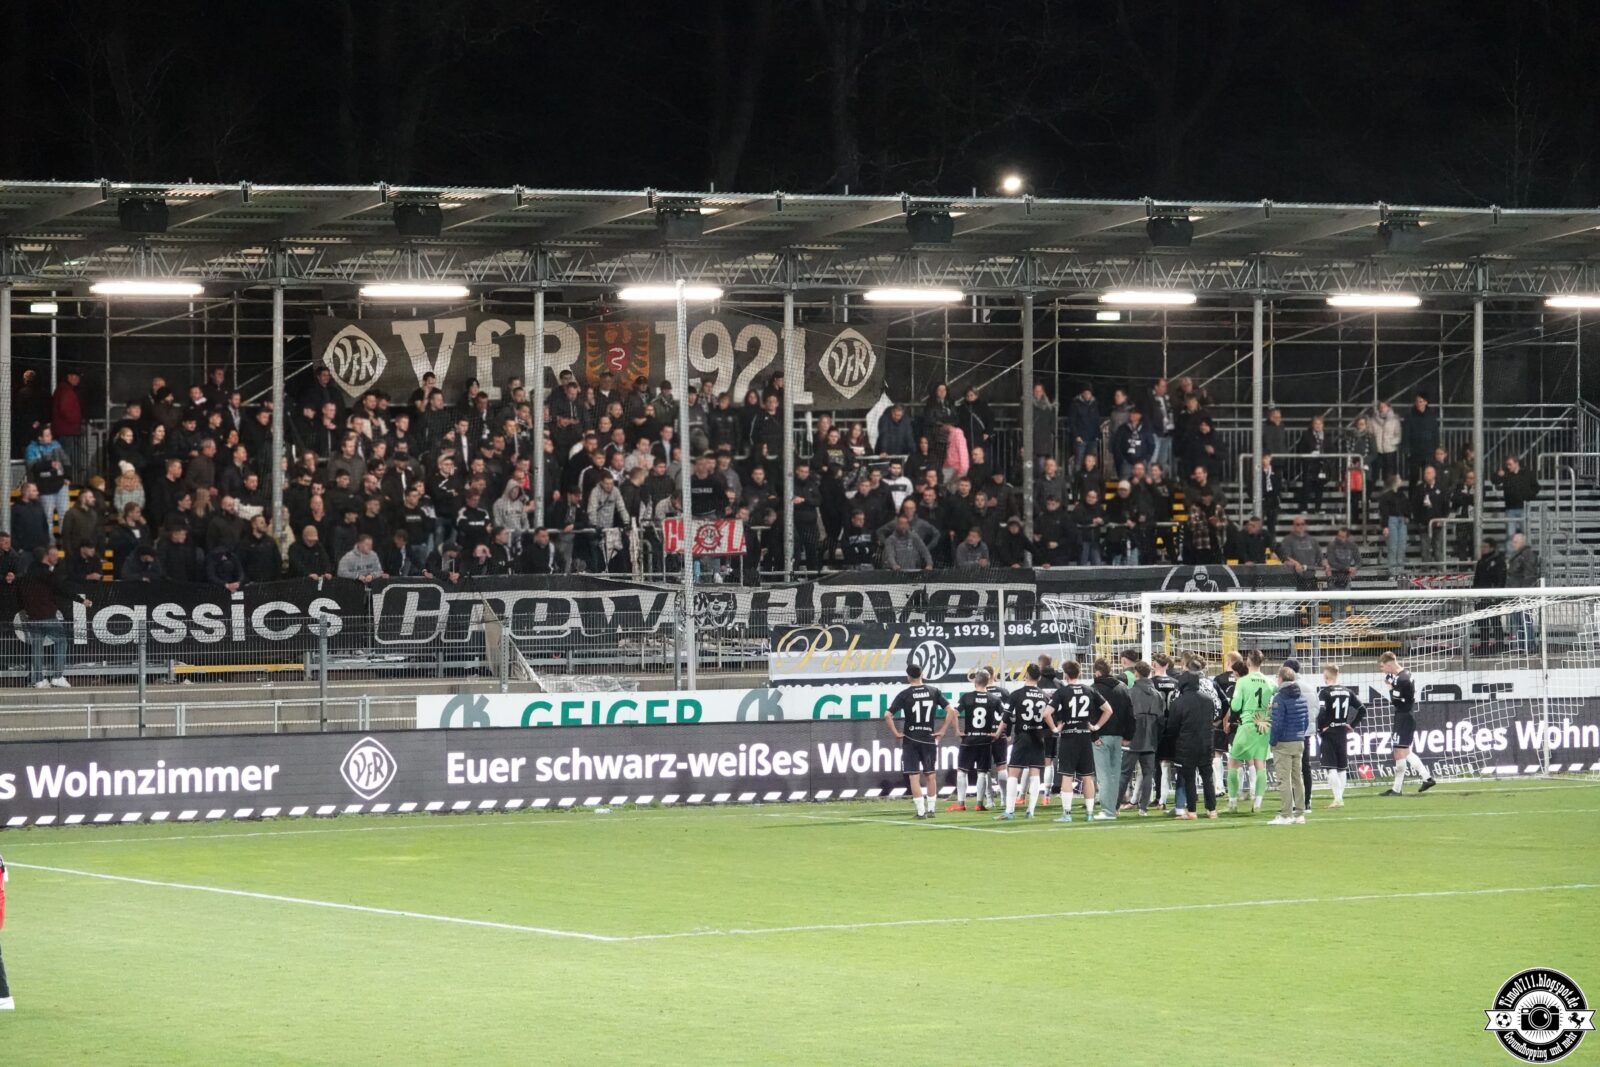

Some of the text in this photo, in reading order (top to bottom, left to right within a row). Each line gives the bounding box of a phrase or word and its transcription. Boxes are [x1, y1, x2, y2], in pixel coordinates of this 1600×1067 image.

[391, 316, 814, 406] VfR 1921
[909, 624, 950, 640] 1972,
[954, 622, 995, 639] 1979,
[1068, 695, 1090, 718] 12
[1254, 687, 1263, 708] 1
[1332, 697, 1349, 719] 11
[911, 700, 934, 723] 17
[972, 707, 987, 729] 8
[1021, 699, 1047, 722] 33
[447, 751, 526, 784] Euer
[535, 743, 808, 782] schwarz-weißes
[26, 760, 280, 799] Wohnzimmer
